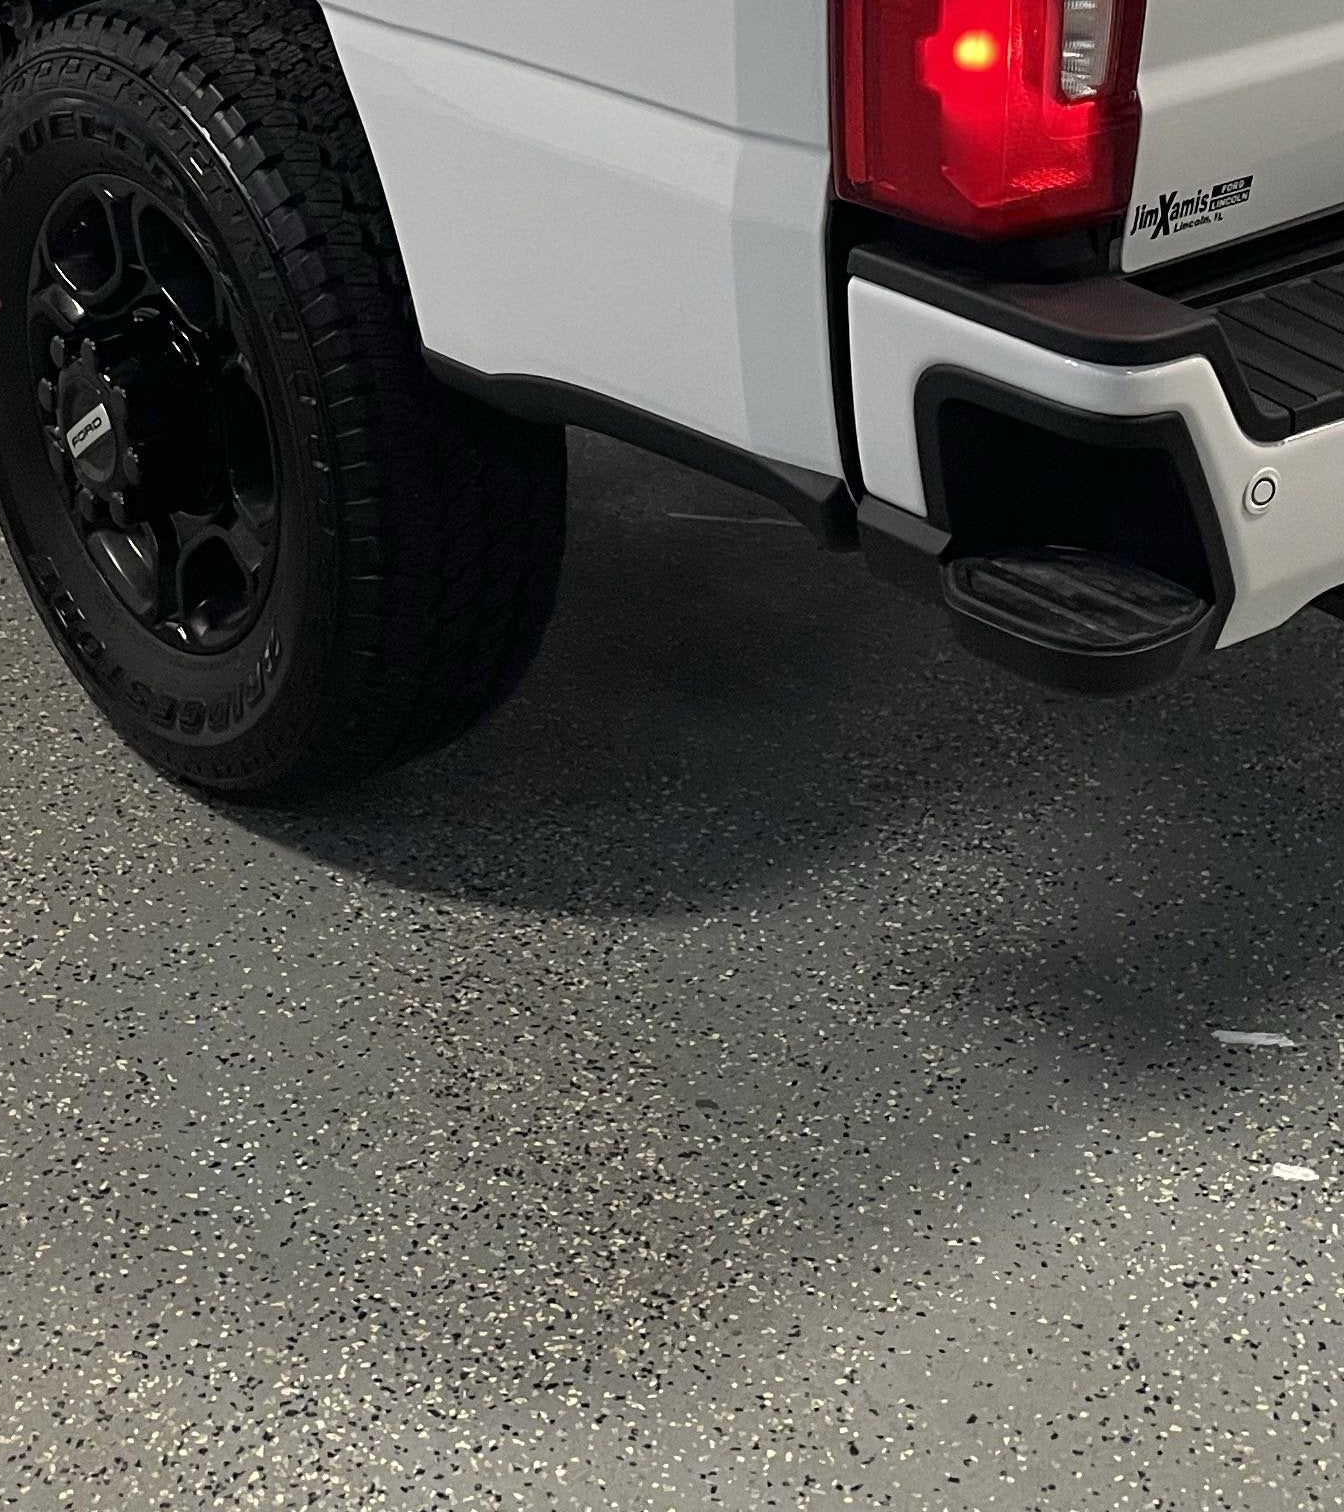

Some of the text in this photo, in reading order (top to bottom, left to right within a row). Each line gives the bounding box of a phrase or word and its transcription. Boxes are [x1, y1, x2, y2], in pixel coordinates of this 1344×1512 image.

[1221, 179, 1245, 193] FORD
[1210, 190, 1250, 210] LINCOLN
[71, 416, 102, 448] FORD
